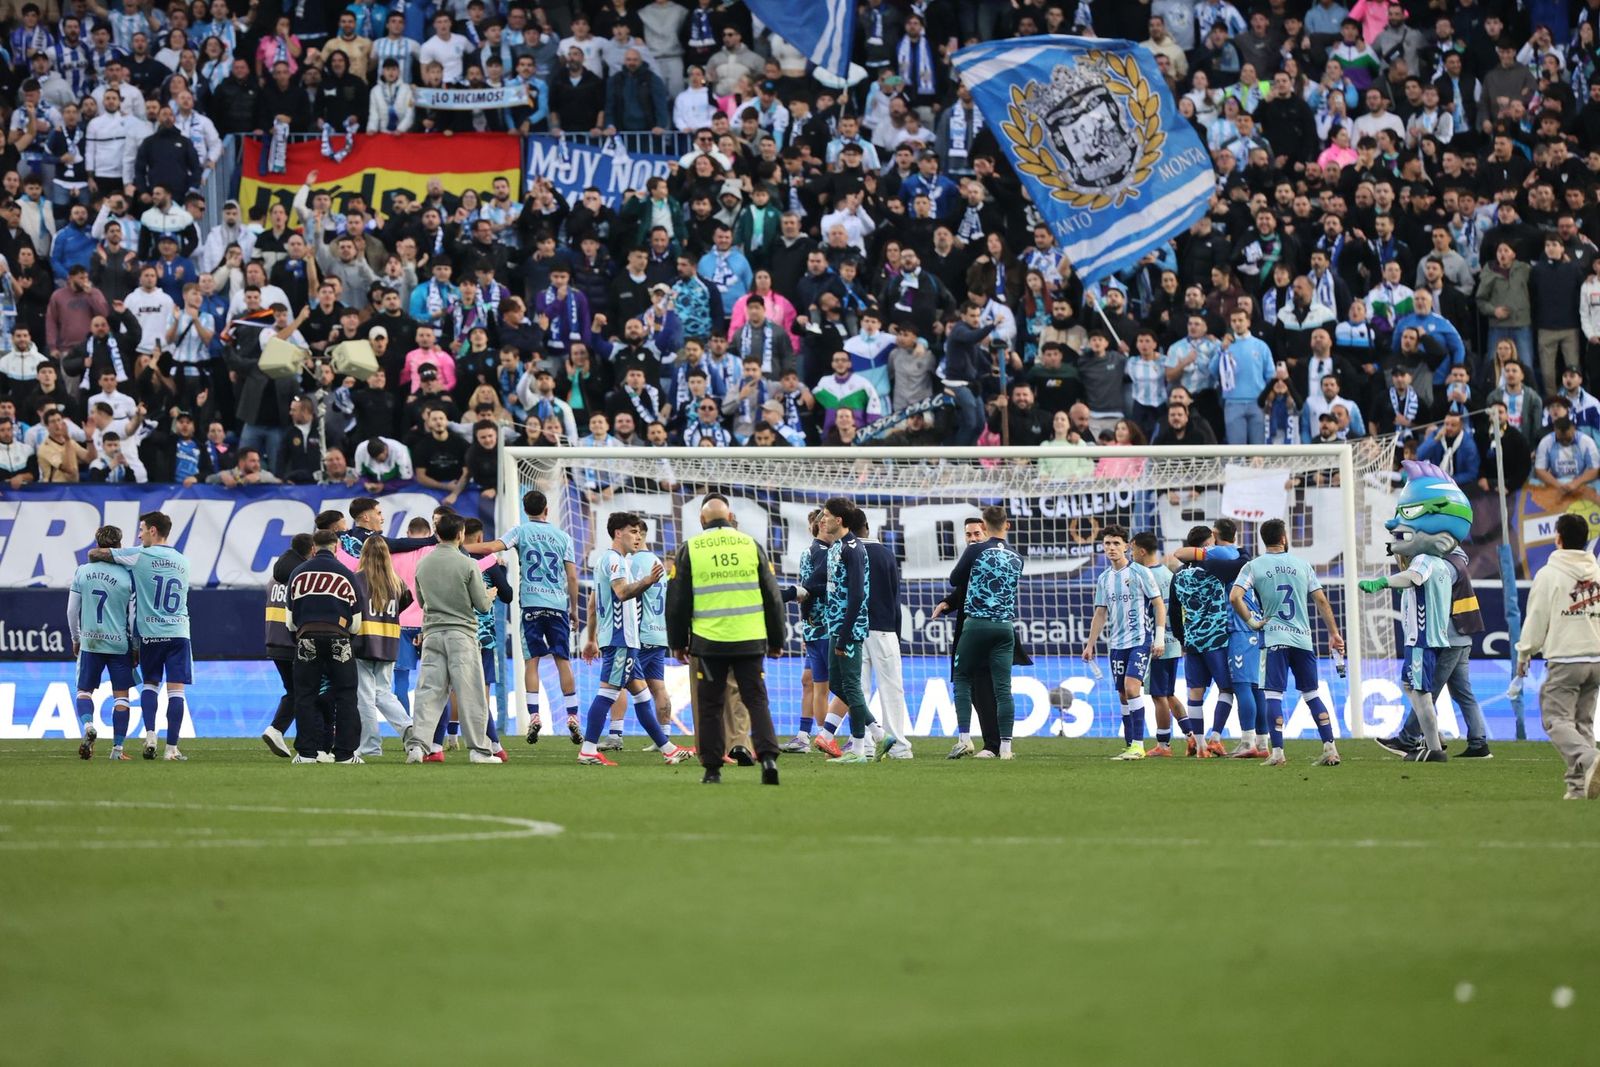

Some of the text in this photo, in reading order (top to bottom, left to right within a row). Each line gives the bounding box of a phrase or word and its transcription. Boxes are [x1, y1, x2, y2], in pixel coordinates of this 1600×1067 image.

[1009, 491, 1033, 517] EL
[694, 536, 750, 549] SEGURIDAD
[525, 549, 559, 583] 23
[711, 553, 739, 567] 185
[711, 570, 756, 579] PROSEGUR
[1275, 565, 1297, 576] PUGA
[86, 571, 118, 587] HAITAM
[152, 574, 183, 614] 16
[1276, 583, 1296, 621] 3
[92, 589, 108, 624] 7
[1112, 660, 1125, 675] 35
